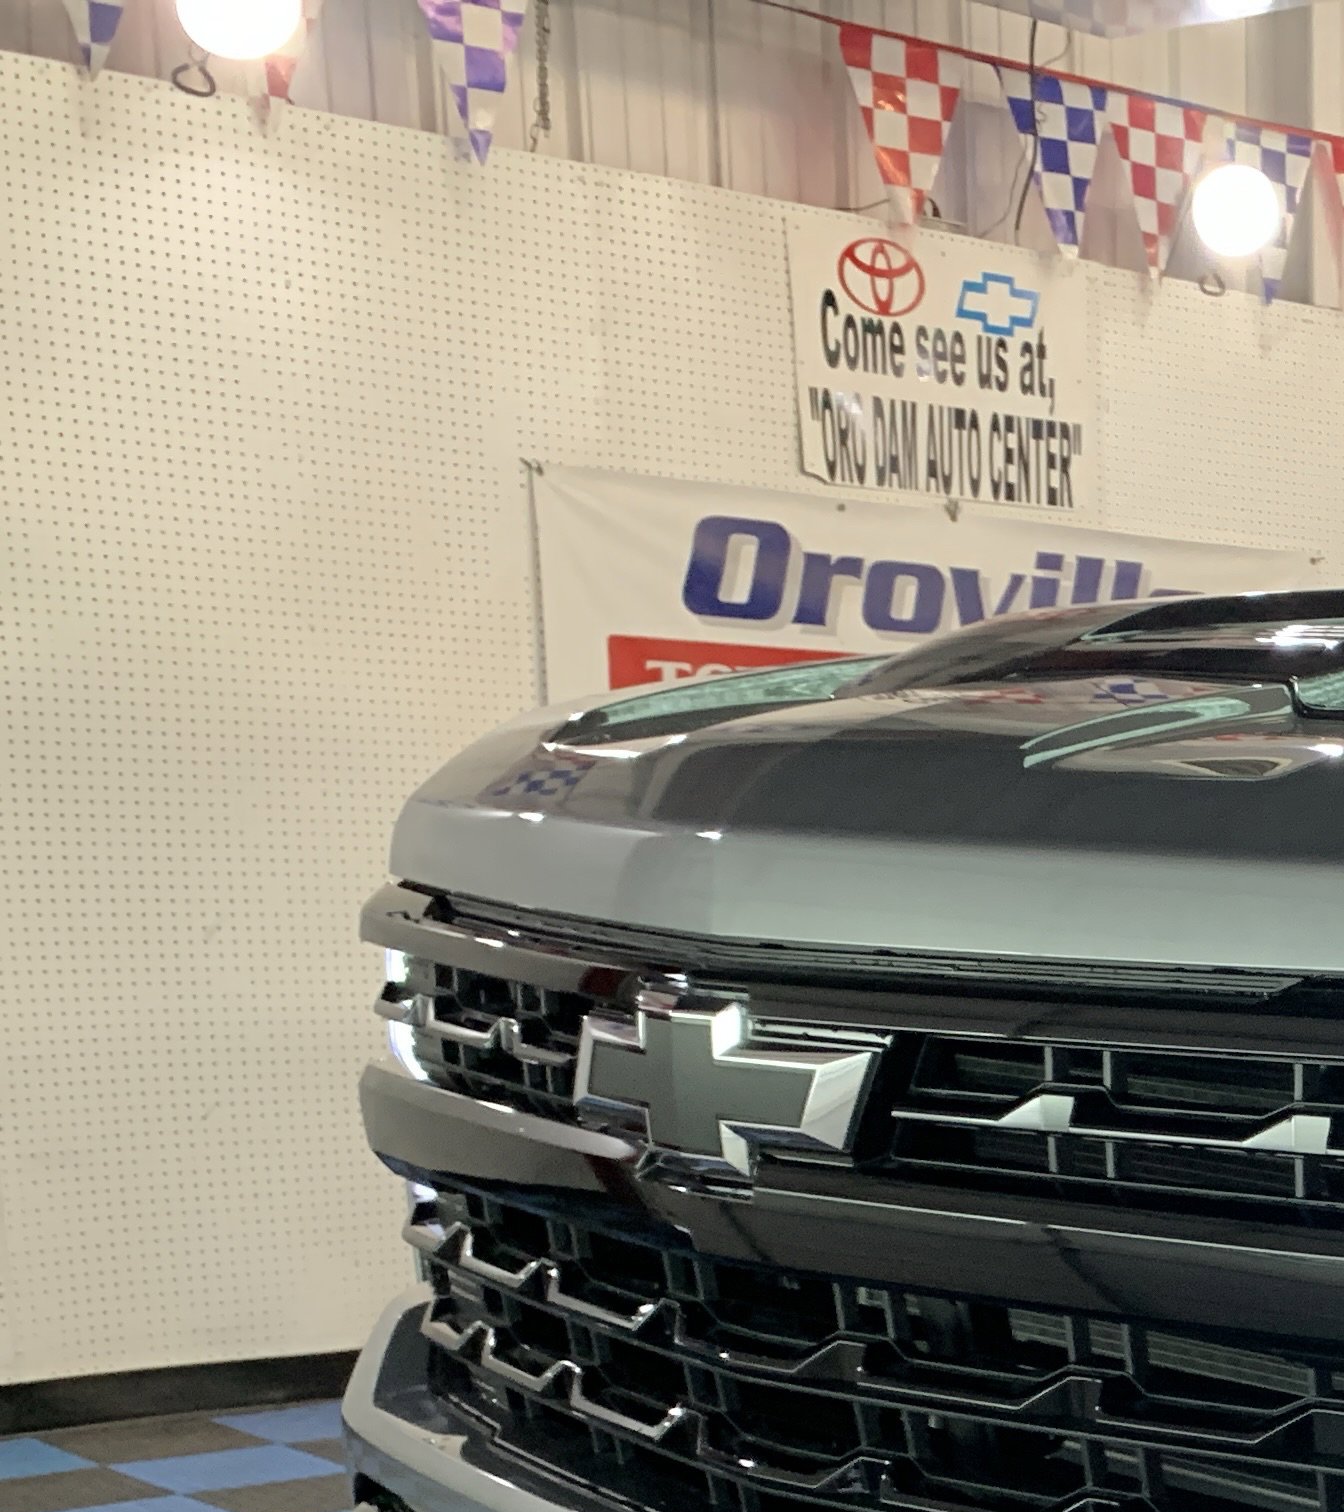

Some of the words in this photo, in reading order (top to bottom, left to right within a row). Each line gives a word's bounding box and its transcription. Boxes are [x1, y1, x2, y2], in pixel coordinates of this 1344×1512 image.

[820, 288, 905, 378] Come
[916, 325, 966, 386] see
[977, 334, 1009, 392] us
[1020, 327, 1056, 415] at,
[872, 395, 919, 490] DAM
[926, 403, 981, 499] AUTO
[989, 411, 1082, 508] CENTER"
[681, 515, 1205, 635] Orovil
